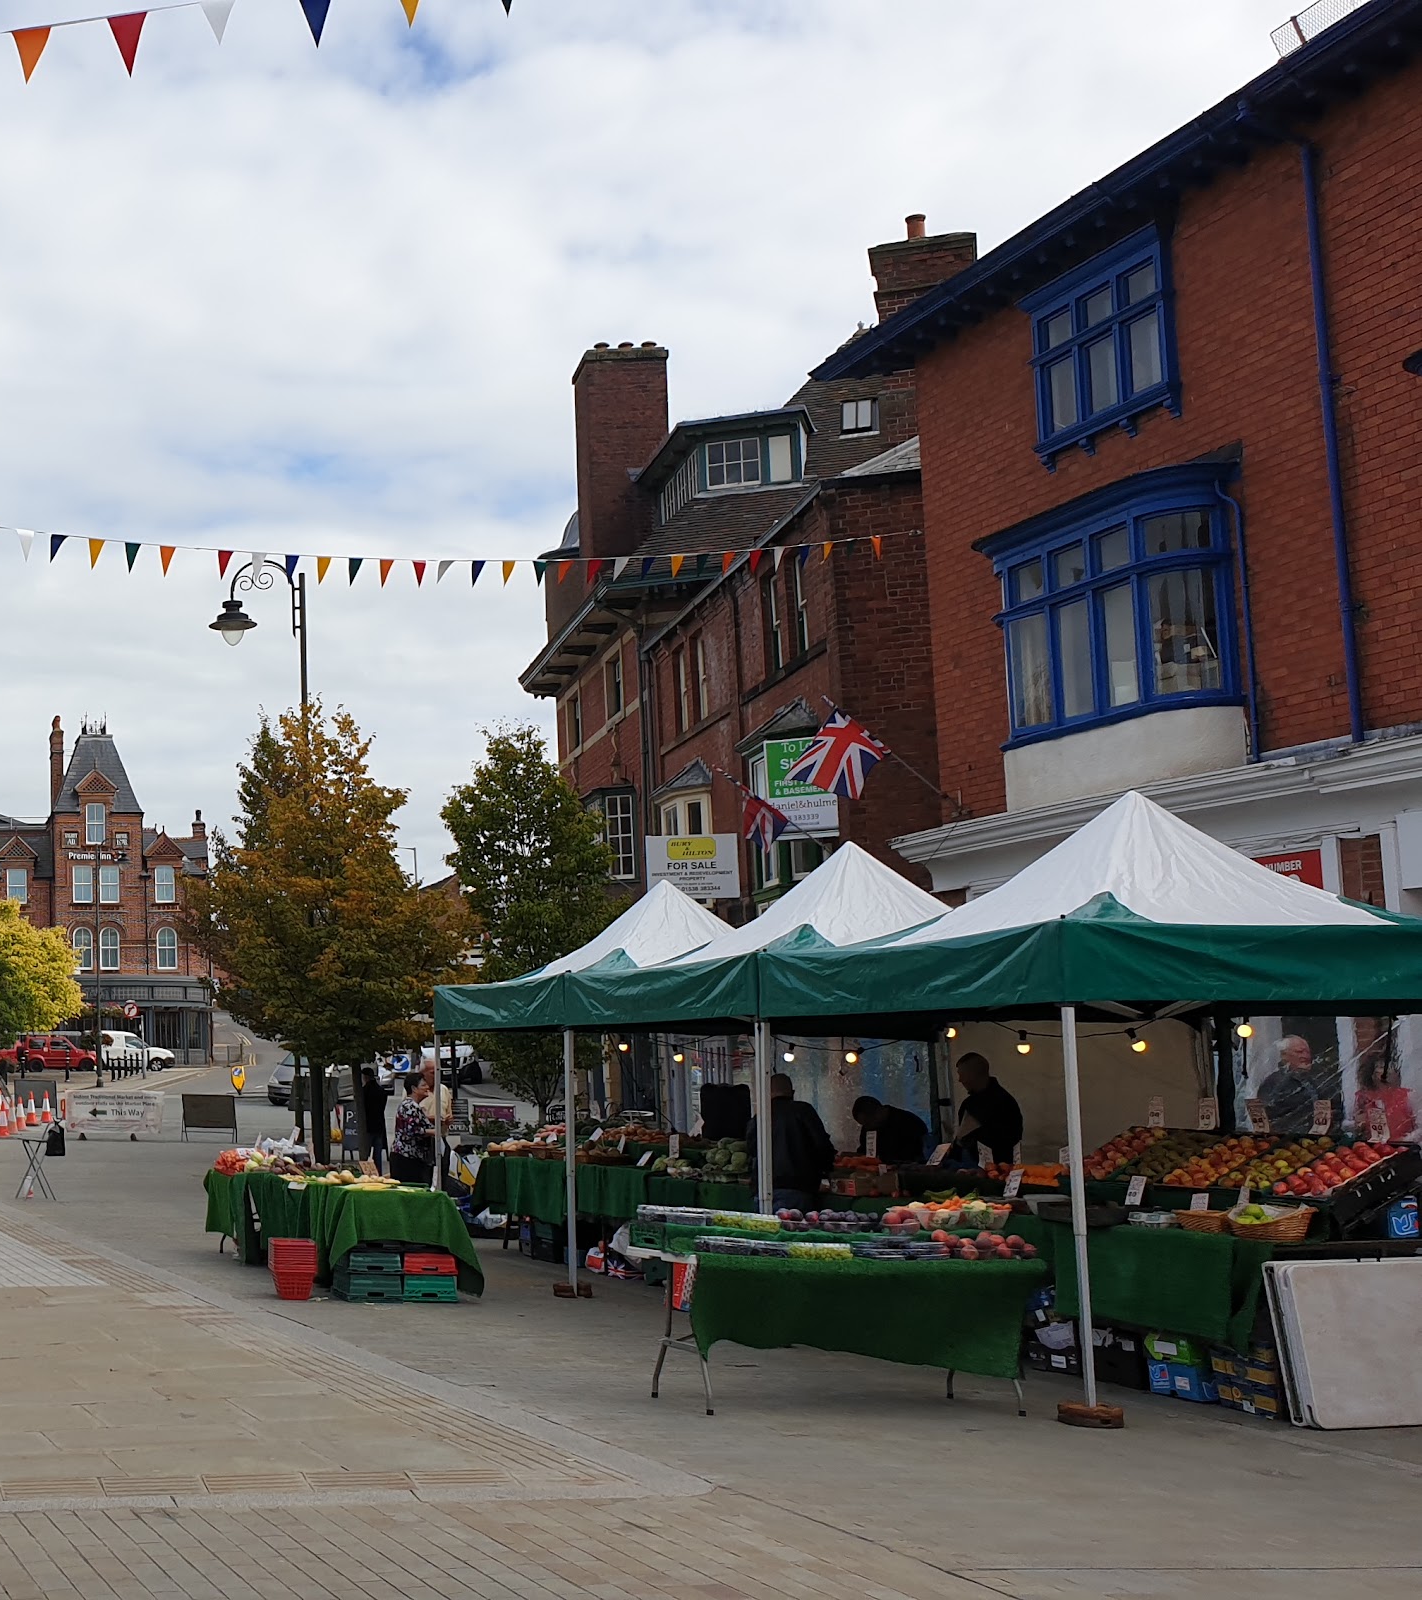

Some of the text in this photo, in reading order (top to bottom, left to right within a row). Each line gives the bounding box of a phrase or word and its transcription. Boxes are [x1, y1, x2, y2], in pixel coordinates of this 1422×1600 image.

[781, 743, 796, 753] To
[775, 788, 781, 796] &
[667, 861, 717, 870] FOR SALE
[111, 1108, 145, 1118] This Way
